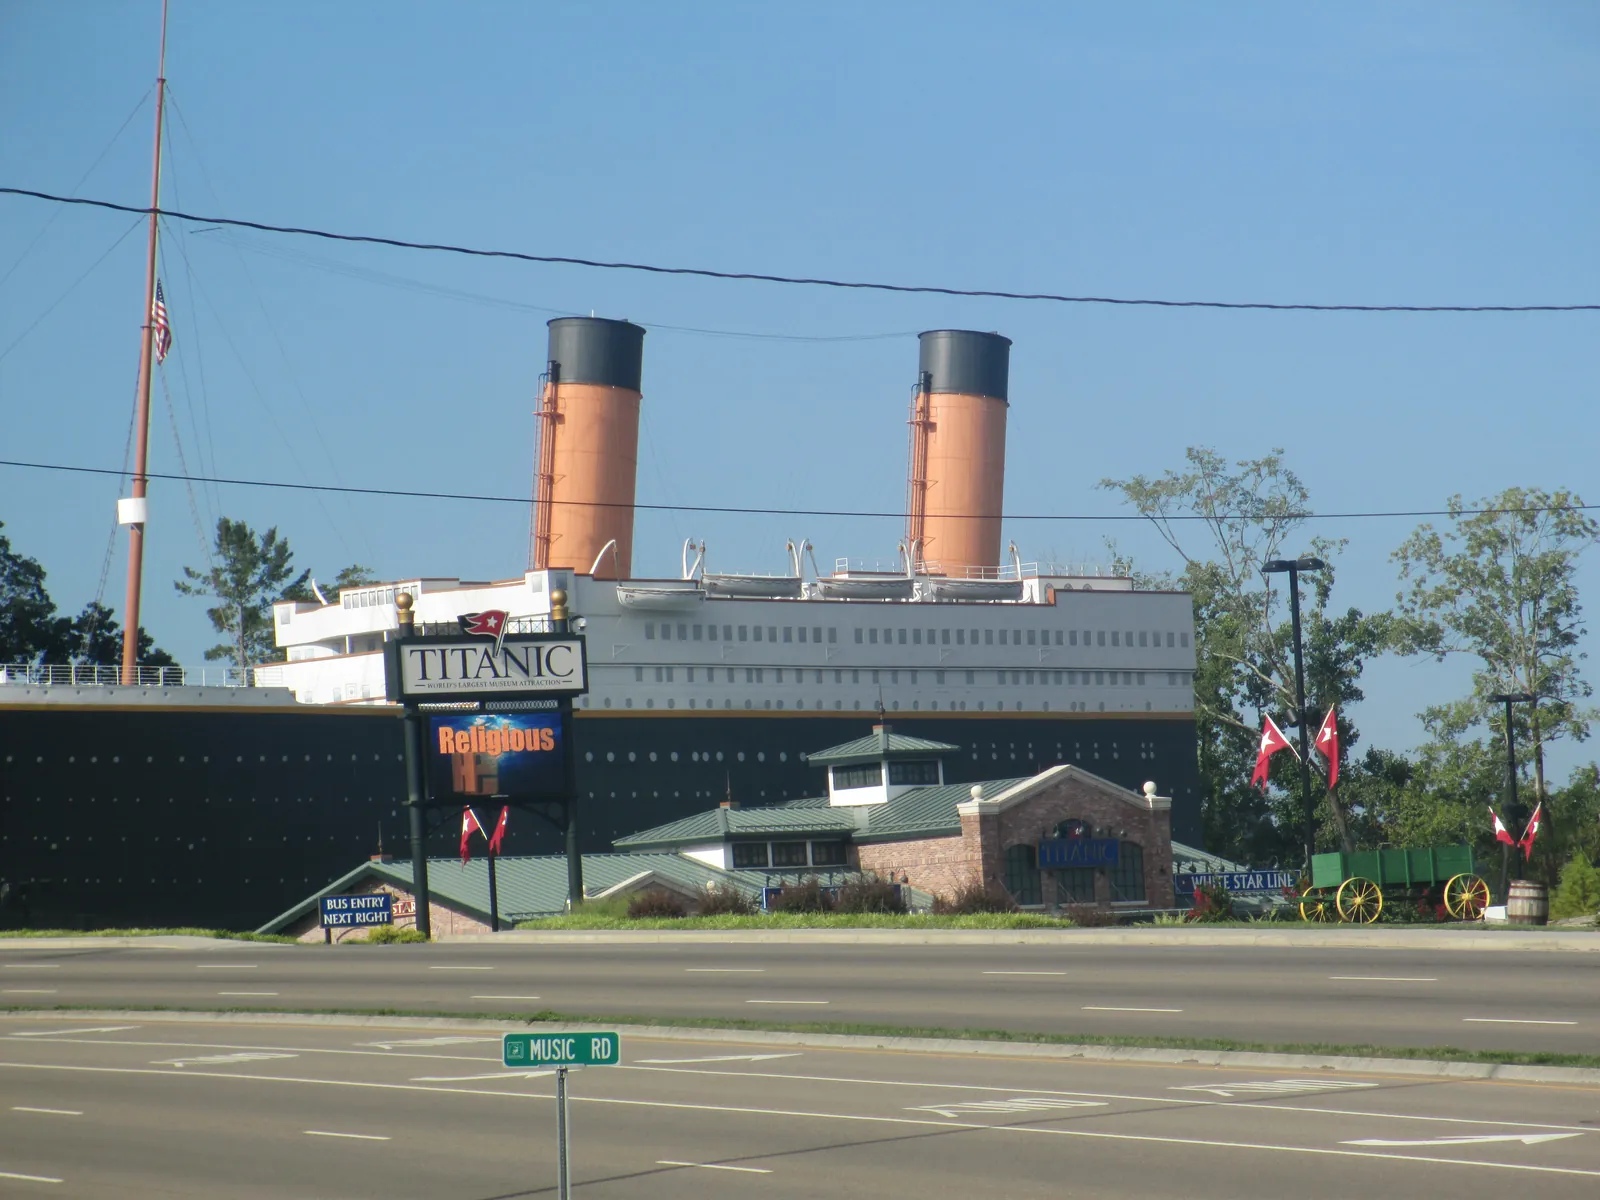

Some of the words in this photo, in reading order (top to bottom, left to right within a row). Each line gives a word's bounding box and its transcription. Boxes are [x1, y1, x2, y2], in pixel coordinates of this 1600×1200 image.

[409, 645, 574, 681] TITANIC
[519, 679, 561, 687] ATTRACTION
[439, 725, 555, 756] Religious
[1233, 874, 1264, 889] STAR
[1267, 873, 1294, 888] LINE
[326, 899, 348, 910] BUS
[350, 897, 385, 909] ENTRY
[323, 913, 353, 925] NEXT
[355, 911, 389, 923] RIGHT
[530, 1038, 576, 1060] MUSIC
[591, 1037, 611, 1059] RD
